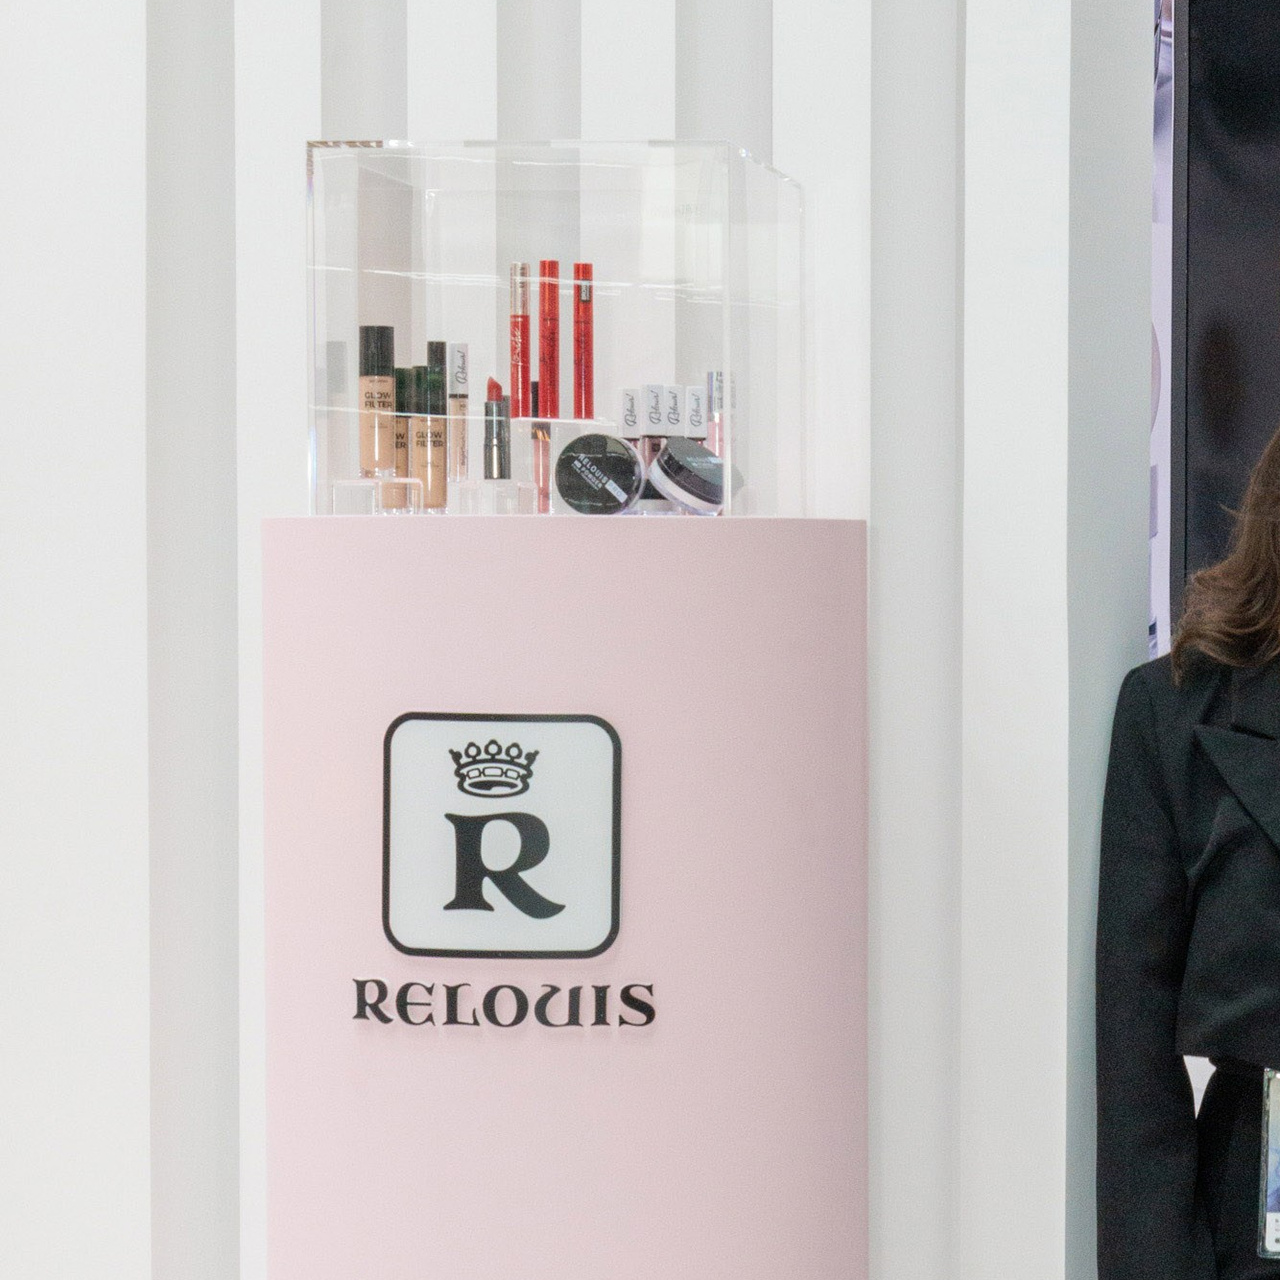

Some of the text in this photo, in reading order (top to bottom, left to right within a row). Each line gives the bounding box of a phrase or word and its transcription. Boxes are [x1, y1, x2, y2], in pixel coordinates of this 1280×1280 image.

[365, 391, 391, 399] GLOW
[365, 401, 392, 409] FILTER
[416, 431, 442, 439] GLOW
[443, 812, 566, 919] R
[352, 978, 656, 1027] RELOUIS
